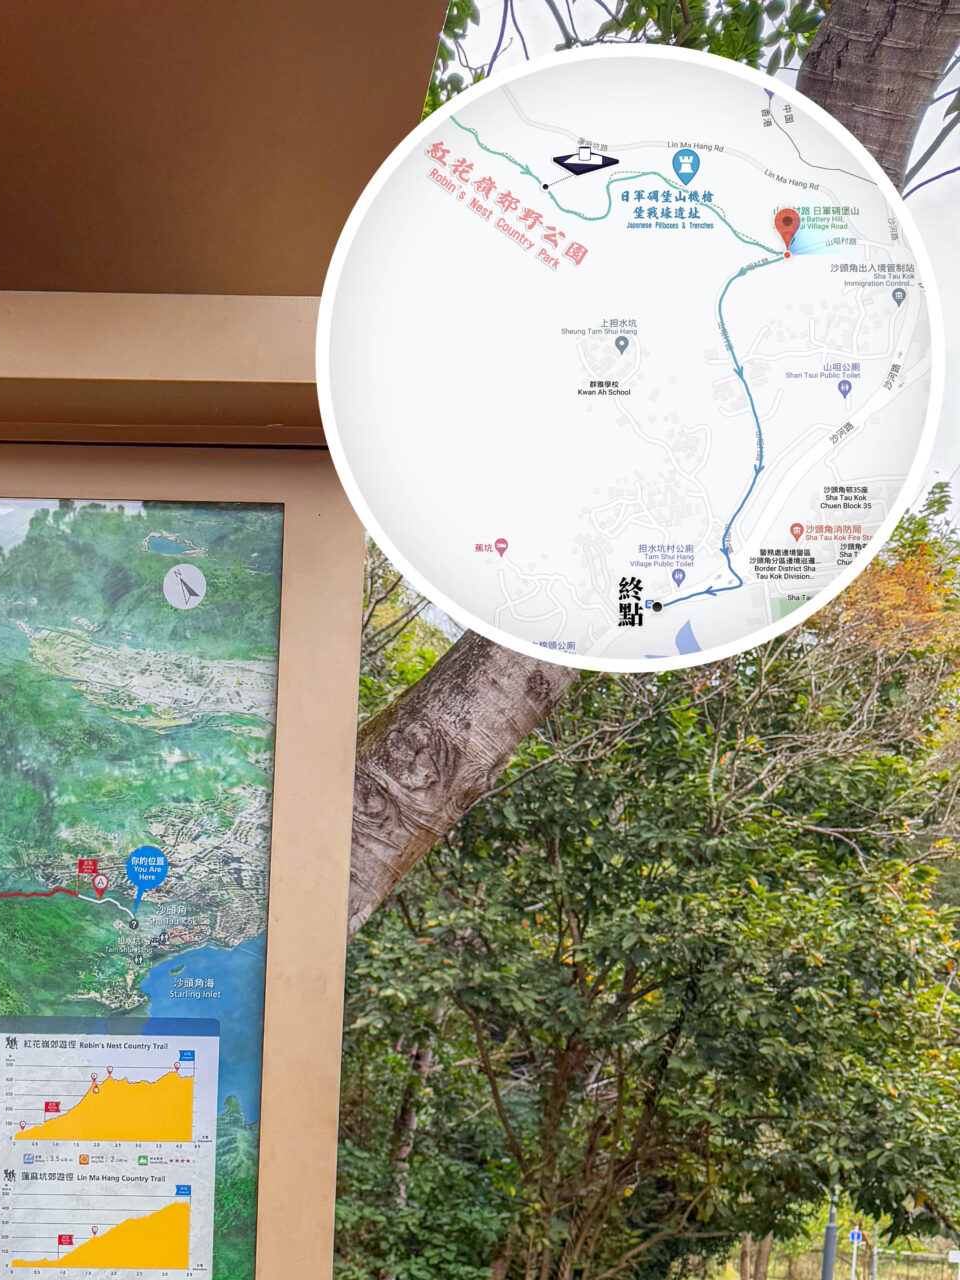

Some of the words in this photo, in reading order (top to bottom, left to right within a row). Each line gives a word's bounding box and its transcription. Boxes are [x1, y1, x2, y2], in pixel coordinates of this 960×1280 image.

[170, 990, 201, 999] Starling
[202, 990, 221, 998] Inlet
[107, 1042, 122, 1050] Nest
[124, 1042, 151, 1051] Country
[102, 1175, 120, 1183] Hang
[122, 1175, 149, 1184] Country
